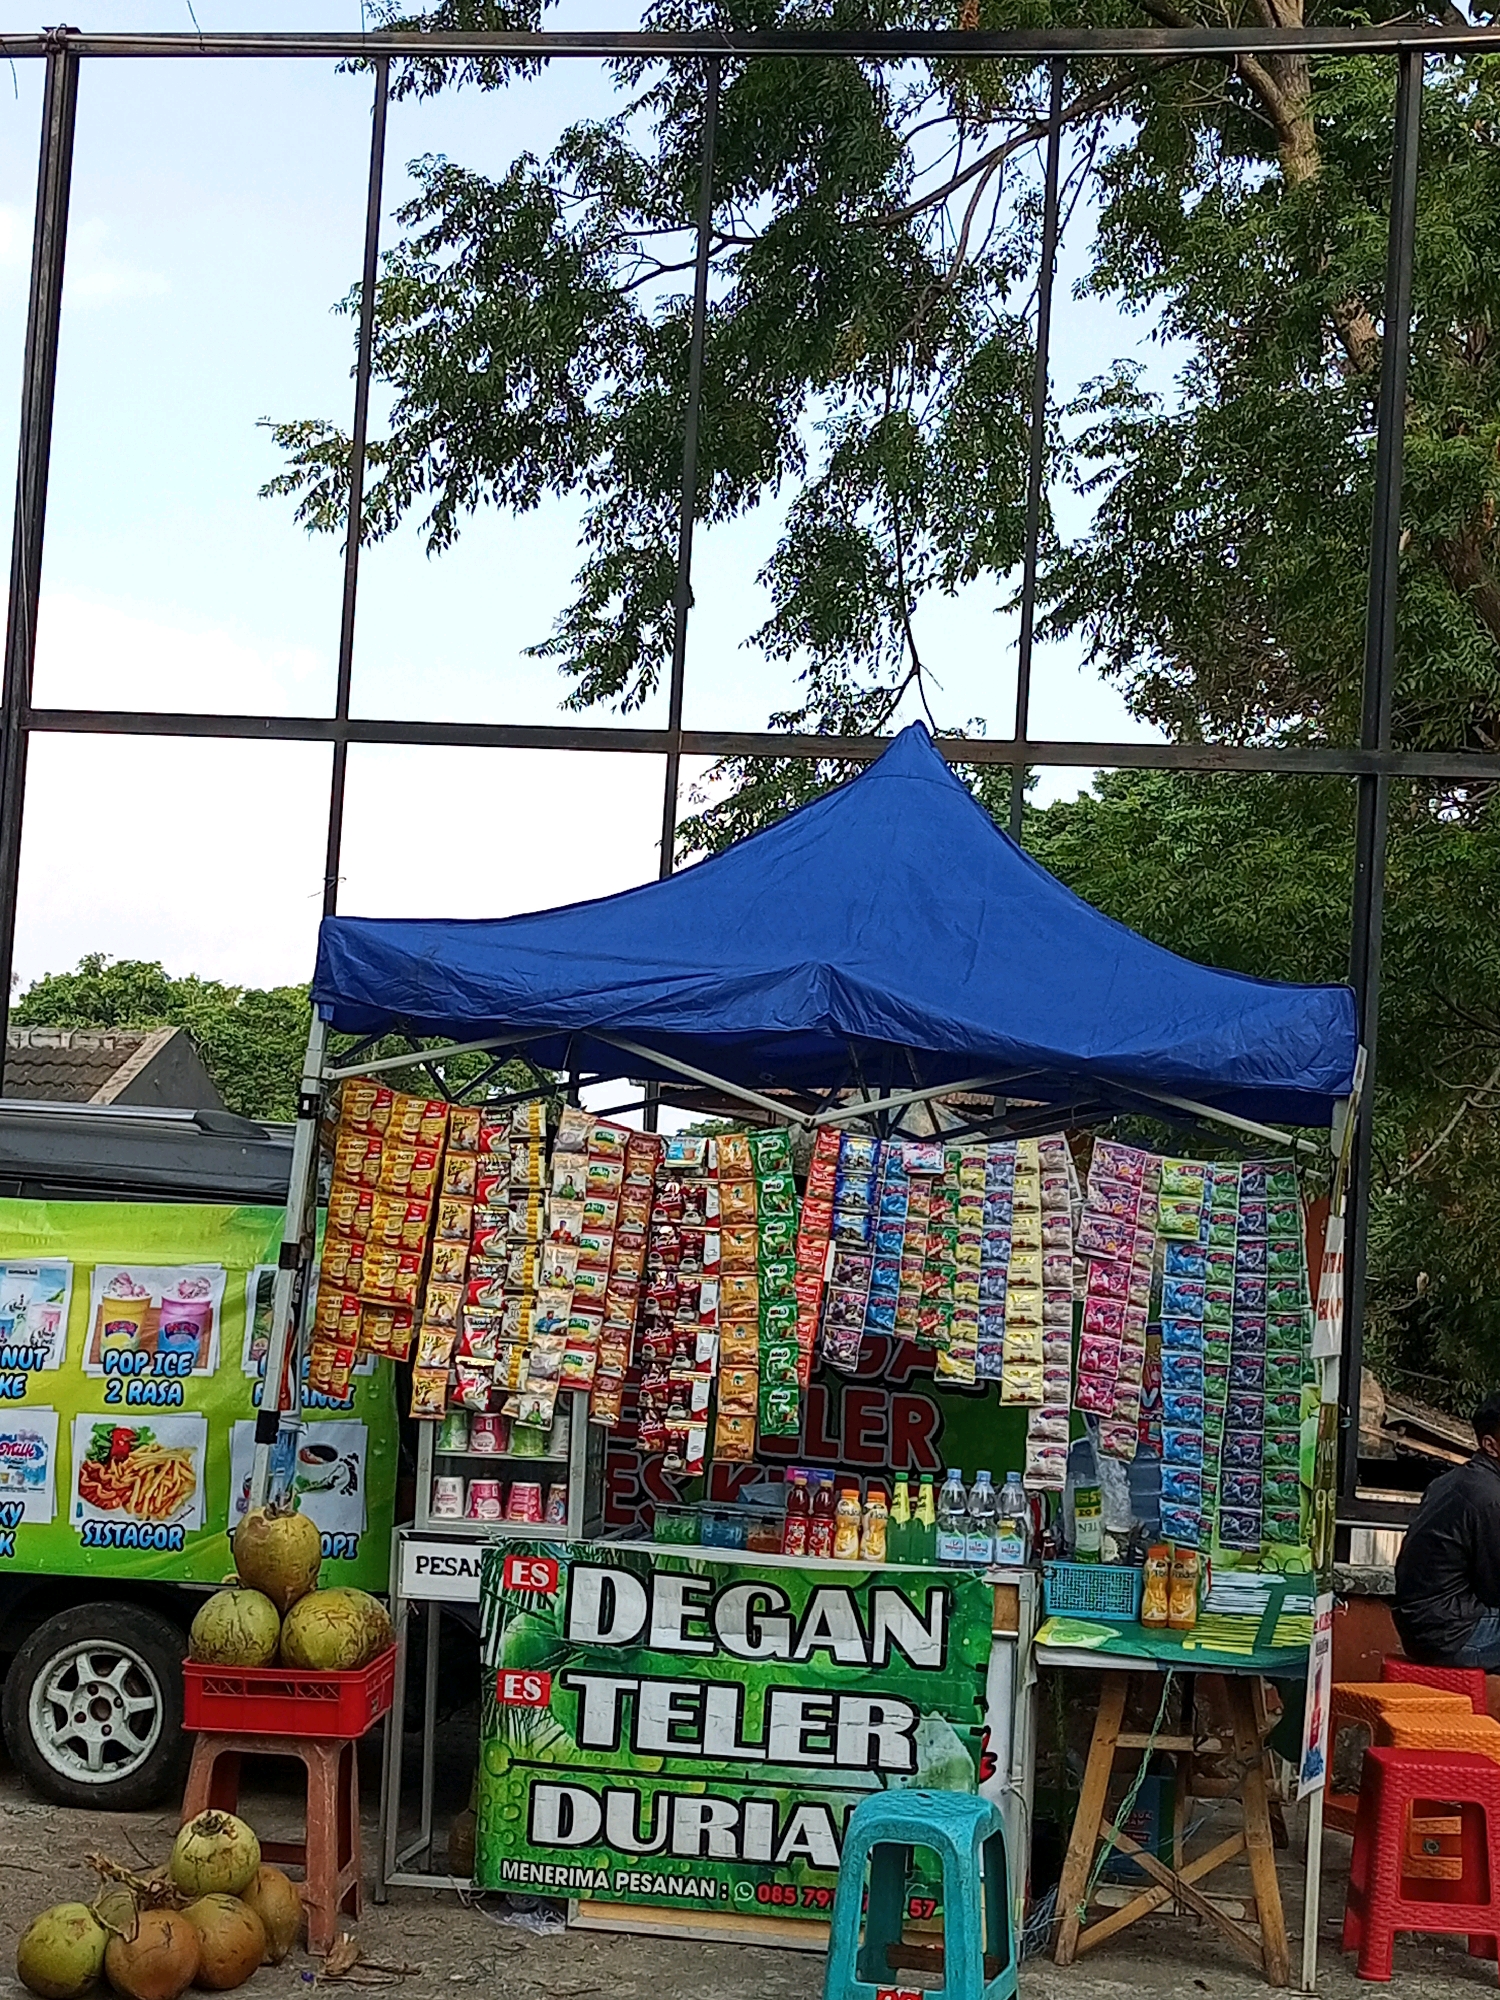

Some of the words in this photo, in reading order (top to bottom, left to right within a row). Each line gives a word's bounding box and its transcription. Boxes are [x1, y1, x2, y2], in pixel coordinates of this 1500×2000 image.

[104, 1349, 149, 1375] POP
[151, 1351, 193, 1377] ICE
[105, 1379, 122, 1402] 2
[127, 1379, 183, 1405] RASA
[82, 1520, 184, 1551] SISTAGOR
[319, 1532, 359, 1559] OPI
[511, 1560, 550, 1588] ES
[567, 1564, 945, 1668] DEGAN
[504, 1673, 542, 1701] ES
[564, 1672, 915, 1771] TELER
[531, 1784, 850, 1868] DURIA
[502, 1860, 609, 1890] MENERIMA
[616, 1871, 716, 1898] PESANAN
[757, 1885, 796, 1903] 085
[803, 1888, 835, 1907] 79
